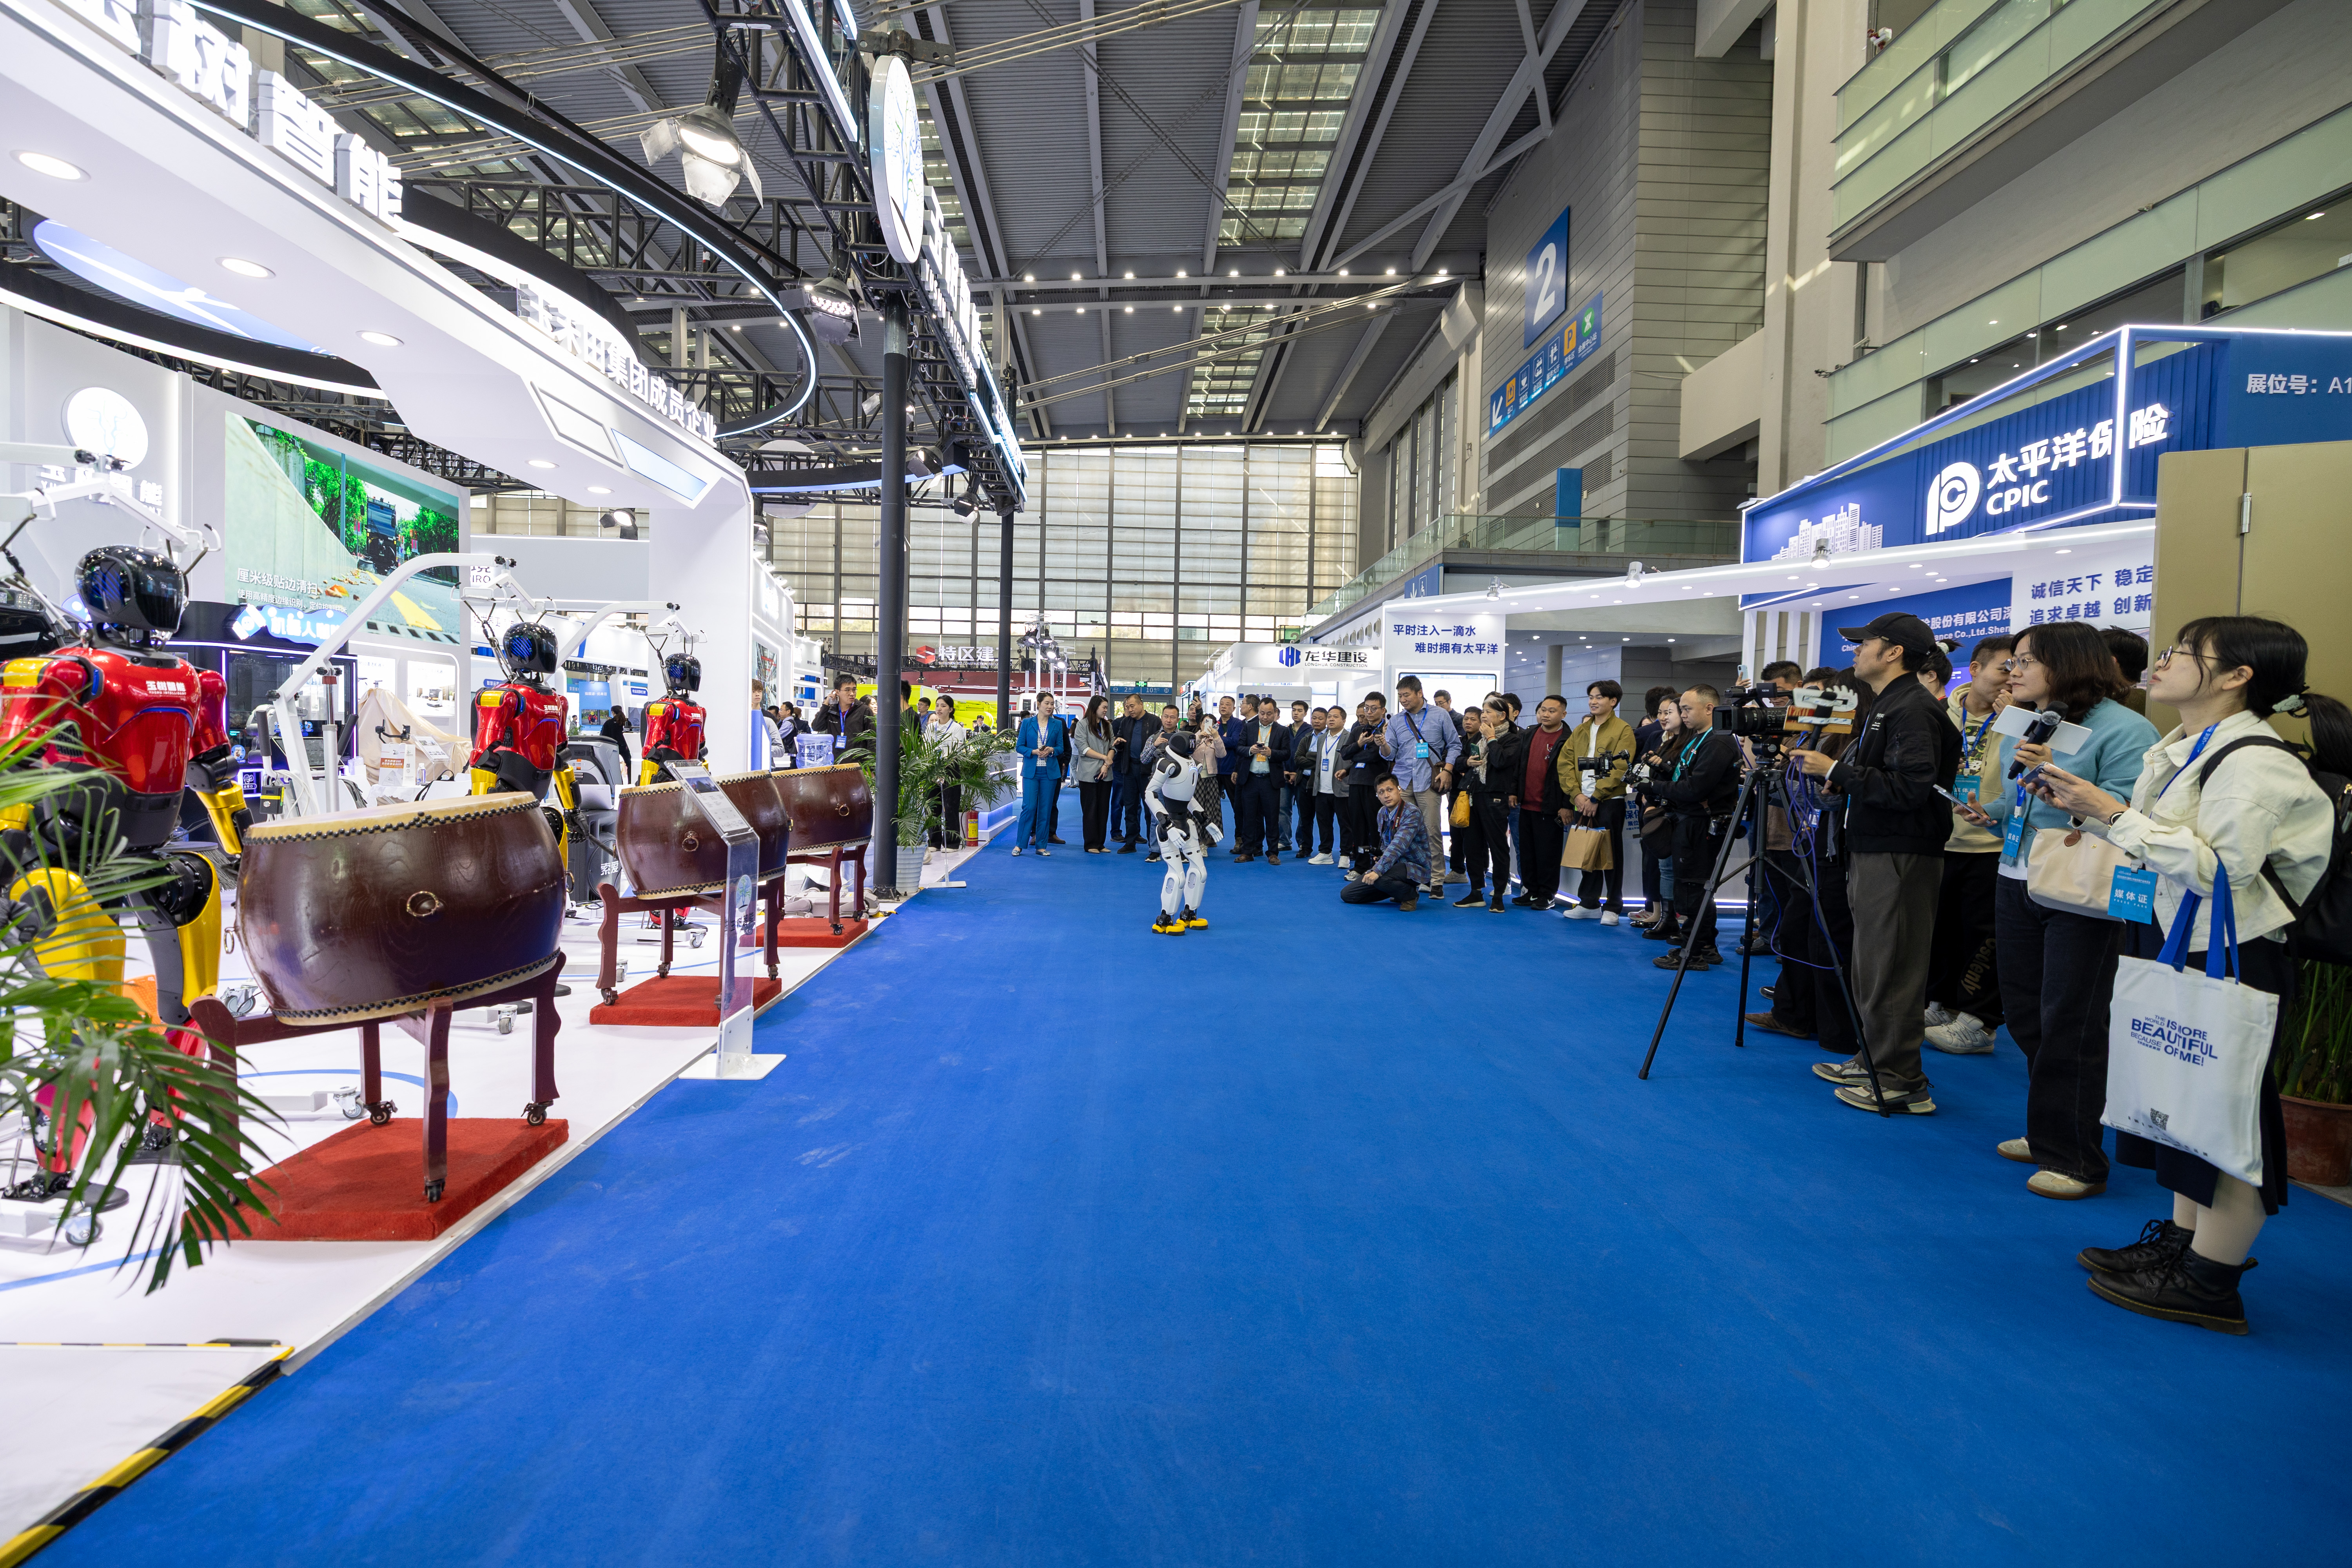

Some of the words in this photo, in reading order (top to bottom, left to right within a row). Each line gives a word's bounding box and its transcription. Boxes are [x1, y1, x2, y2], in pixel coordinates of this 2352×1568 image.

[1533, 242, 1556, 325] 2
[1578, 332, 1597, 354] 会展中心站
[1564, 350, 1575, 366] 停车区
[1546, 364, 1560, 381] 服务大厅
[1986, 480, 2048, 515] CPIC
[237, 567, 318, 596] 厘米级贴边清扫
[2031, 573, 2102, 600] 诚信天下
[2115, 564, 2153, 587] 稳定
[2030, 600, 2101, 626] 追求卓越
[2113, 593, 2151, 615] 创新
[1393, 624, 1476, 637] 平时注入一滴水
[1415, 642, 1498, 654] 难时拥有太平洋
[1305, 650, 1368, 663] 龙华建设
[2007, 832, 2020, 843] 媒体证
[600, 860, 619, 876] 索爱
[2114, 888, 2148, 904] 媒体证
[2145, 1016, 2165, 1027] WORLD
[2166, 1019, 2177, 1030] IS
[2131, 1018, 2218, 1059] BEAUTIFUL
[2131, 1031, 2162, 1047] BECAUSE
[2164, 1044, 2179, 1057] OF
[2180, 1051, 2204, 1066] ME!
